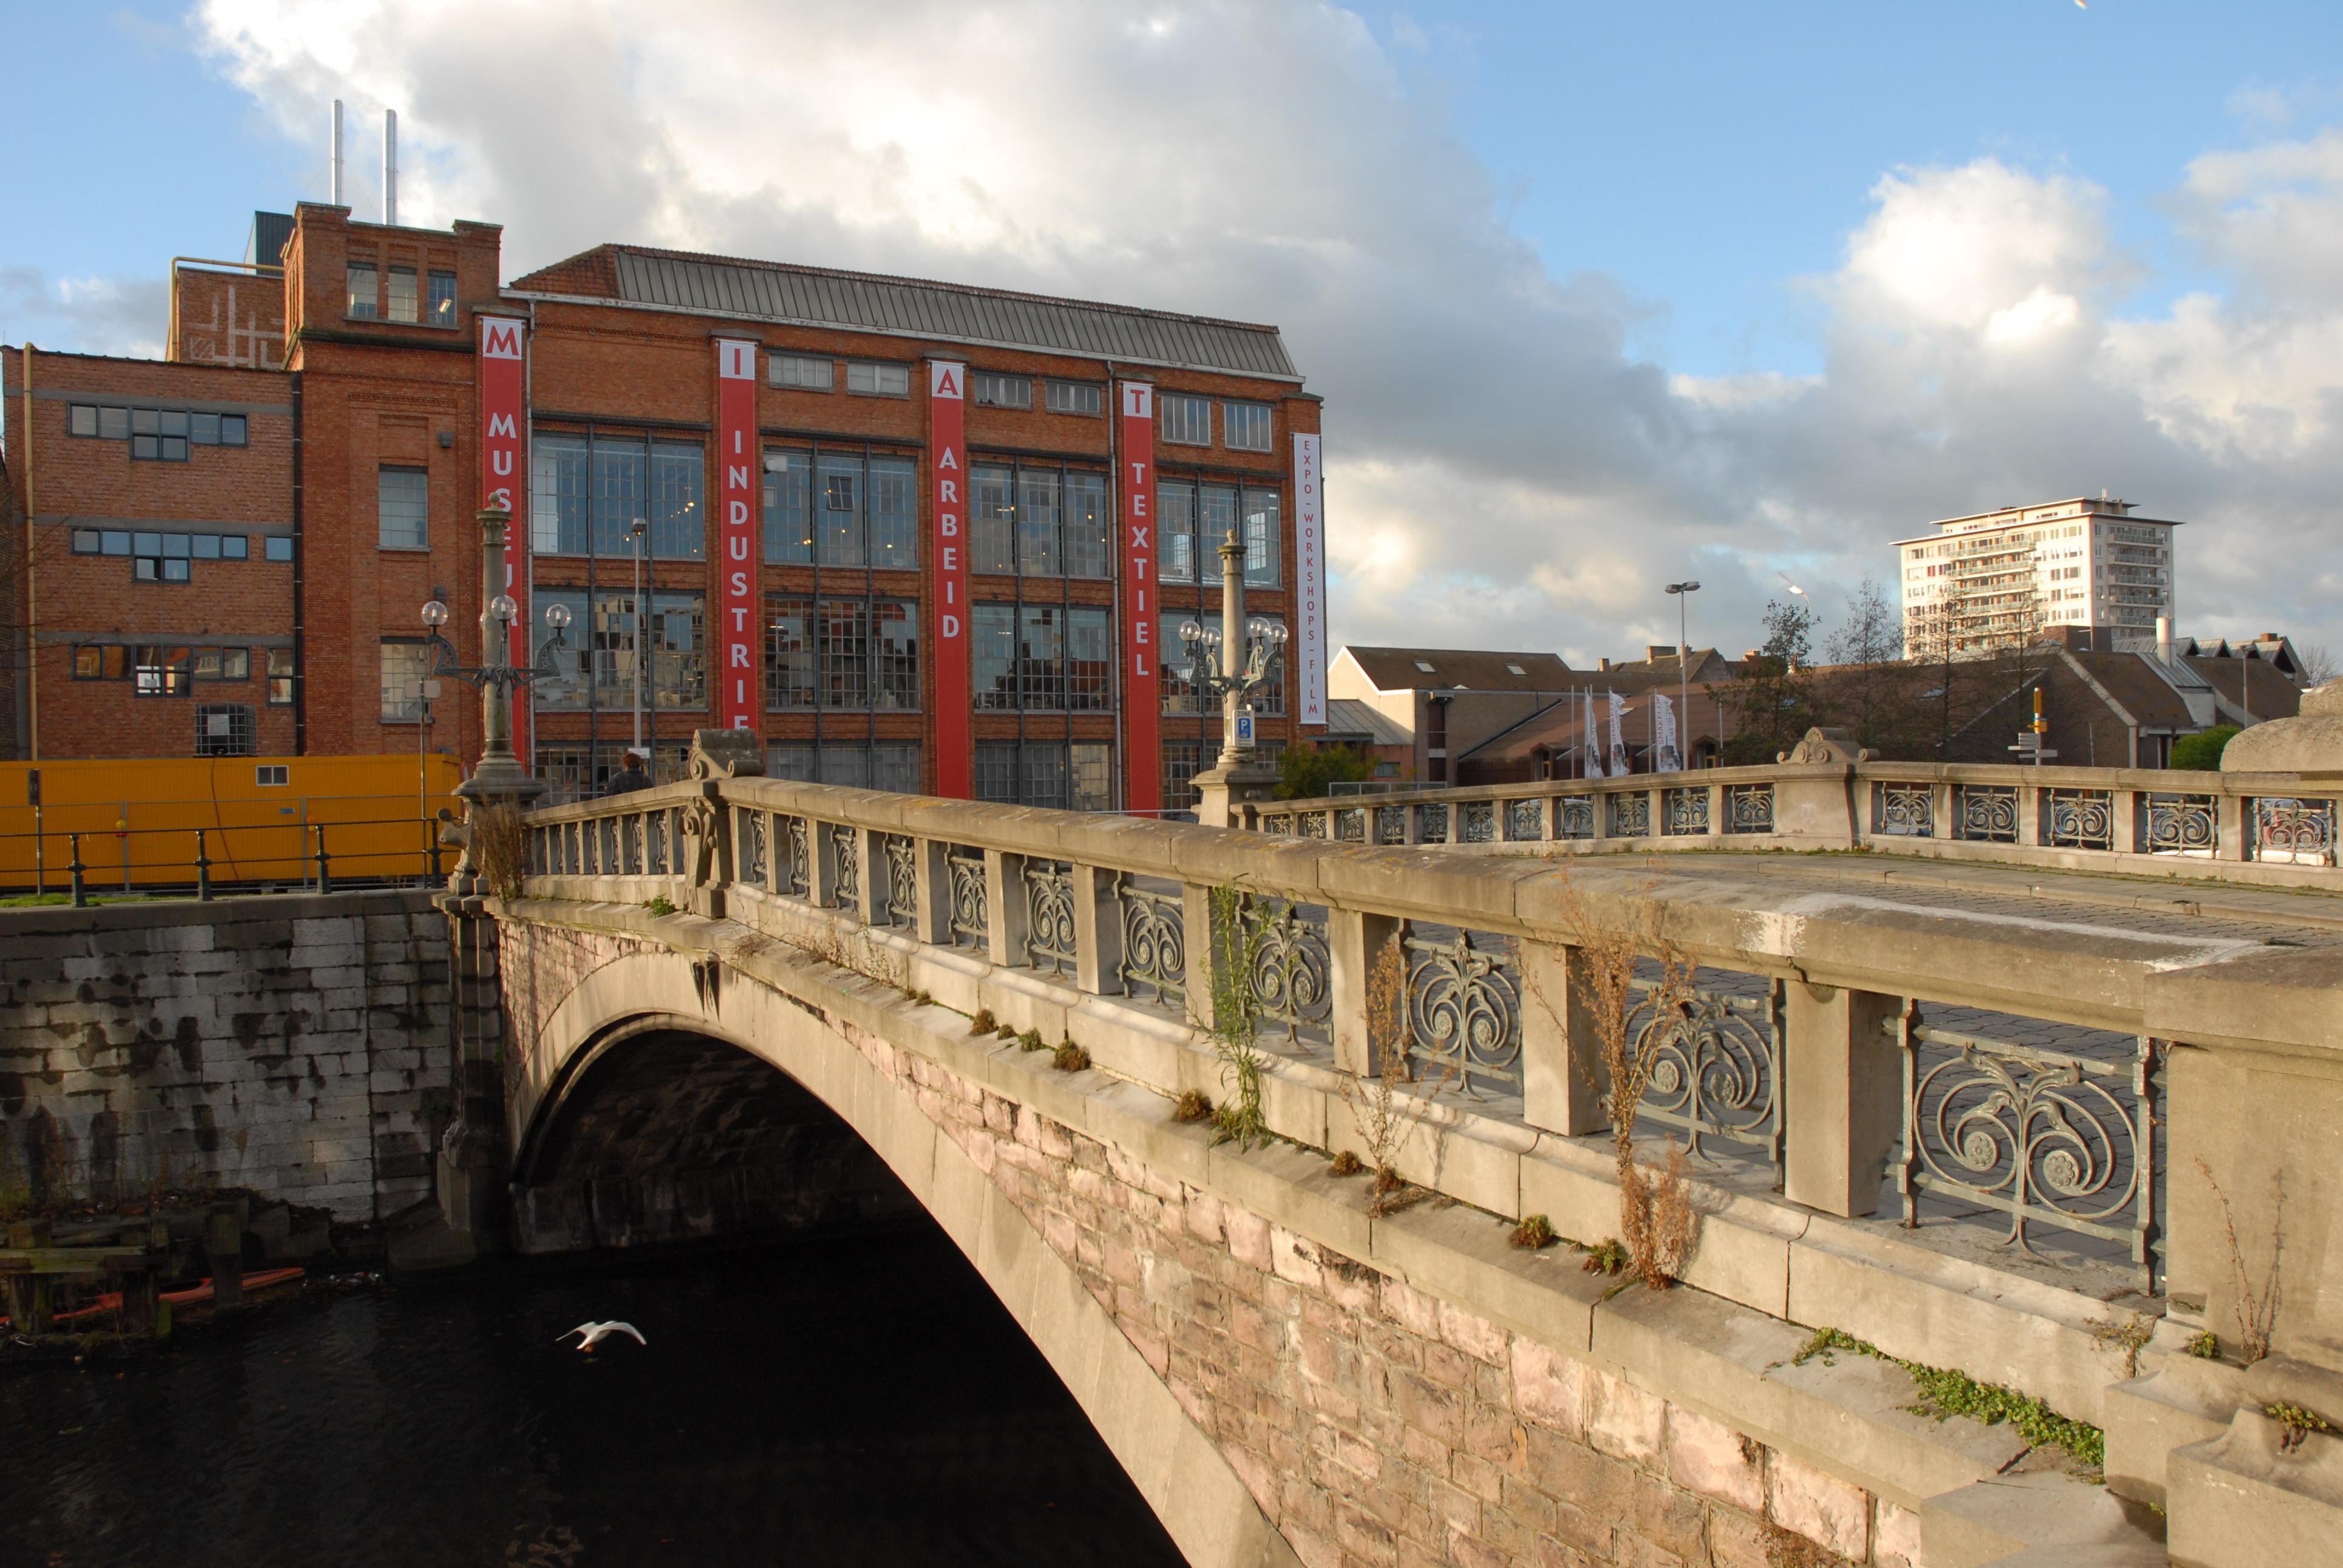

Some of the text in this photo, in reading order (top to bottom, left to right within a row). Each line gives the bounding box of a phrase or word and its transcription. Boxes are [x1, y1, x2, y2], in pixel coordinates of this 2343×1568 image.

[486, 325, 519, 356] M
[733, 348, 741, 375] I
[937, 369, 958, 396] A
[1130, 389, 1145, 414] T
[488, 413, 517, 626] MUS
[939, 446, 959, 638] ARBEID
[1132, 462, 1149, 676] TEXTIEL
[1241, 719, 1248, 730] P
